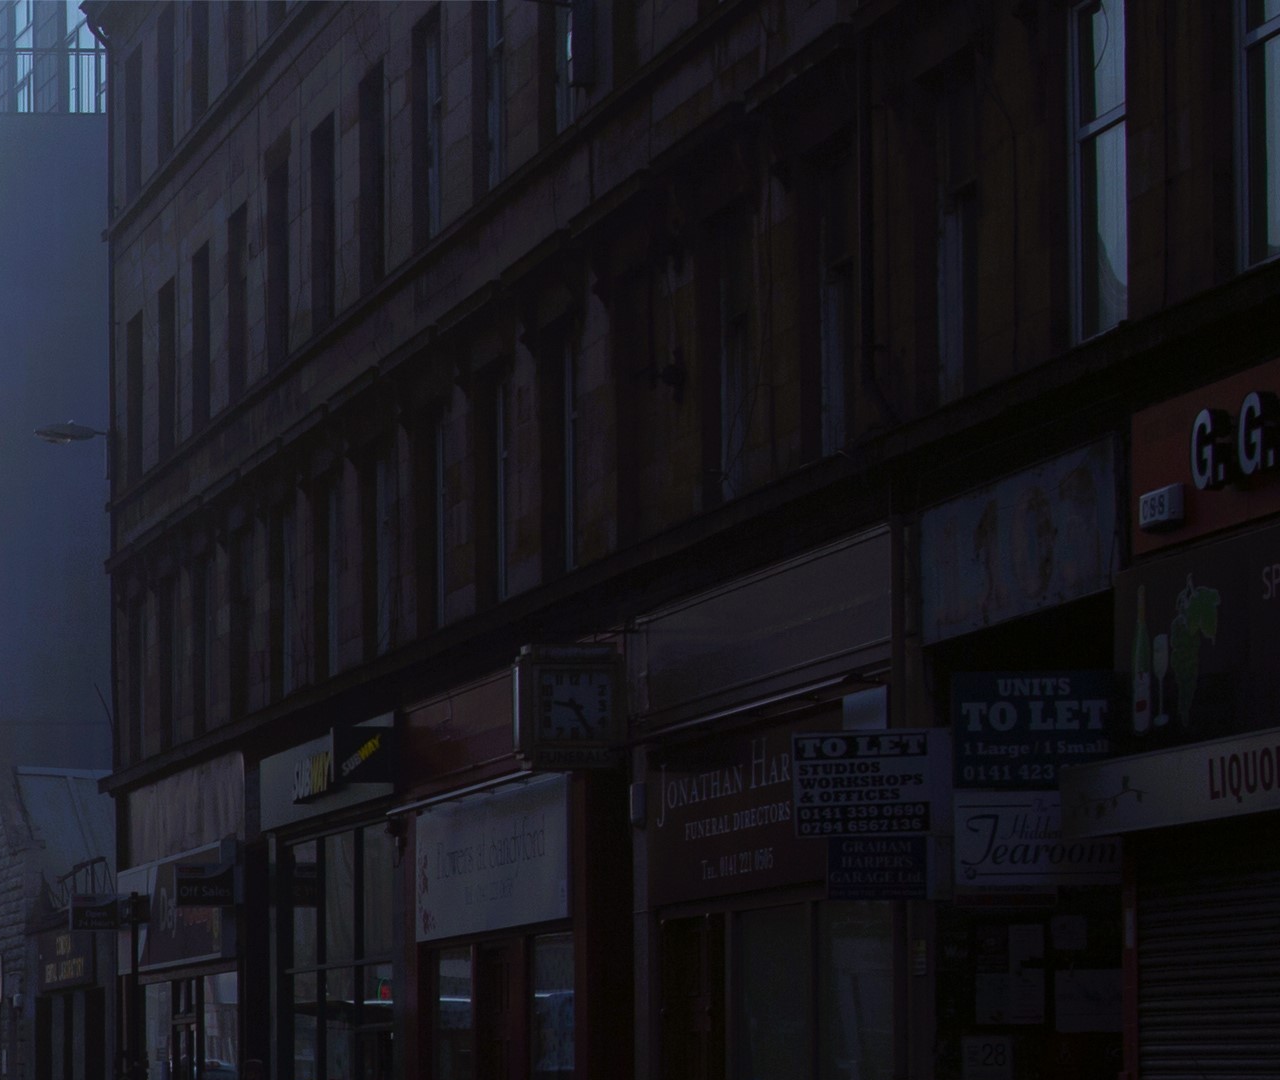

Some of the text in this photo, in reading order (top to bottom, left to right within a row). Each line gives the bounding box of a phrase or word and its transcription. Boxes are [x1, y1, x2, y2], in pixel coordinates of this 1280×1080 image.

[997, 677, 1071, 697] UNITS
[961, 699, 1108, 732] TO LET
[341, 733, 381, 776] SUBWAY
[798, 735, 924, 759] TO LET
[976, 741, 1030, 758] Large
[1057, 739, 1109, 753] Small
[540, 751, 610, 764] FUNERALS
[291, 751, 331, 804] SUBWAY
[799, 761, 880, 776] STUDIOS
[963, 764, 1012, 780] 0141
[1018, 763, 1055, 780] 423
[1209, 746, 1280, 803] LIQUO
[656, 737, 791, 828] JONATHAN HAR
[799, 773, 924, 790] WORKSHOPS
[800, 788, 901, 803] & OFFICES
[685, 801, 791, 841] FUNERAL DIRECTORS
[800, 804, 925, 820] 0141 339 0690
[801, 821, 843, 834] 0794
[842, 840, 912, 853] GRAHAM
[961, 814, 1117, 865] Tearoom
[830, 871, 893, 883] GARAGE
[180, 885, 230, 897] Off Sales
[983, 1043, 1006, 1066] 28
